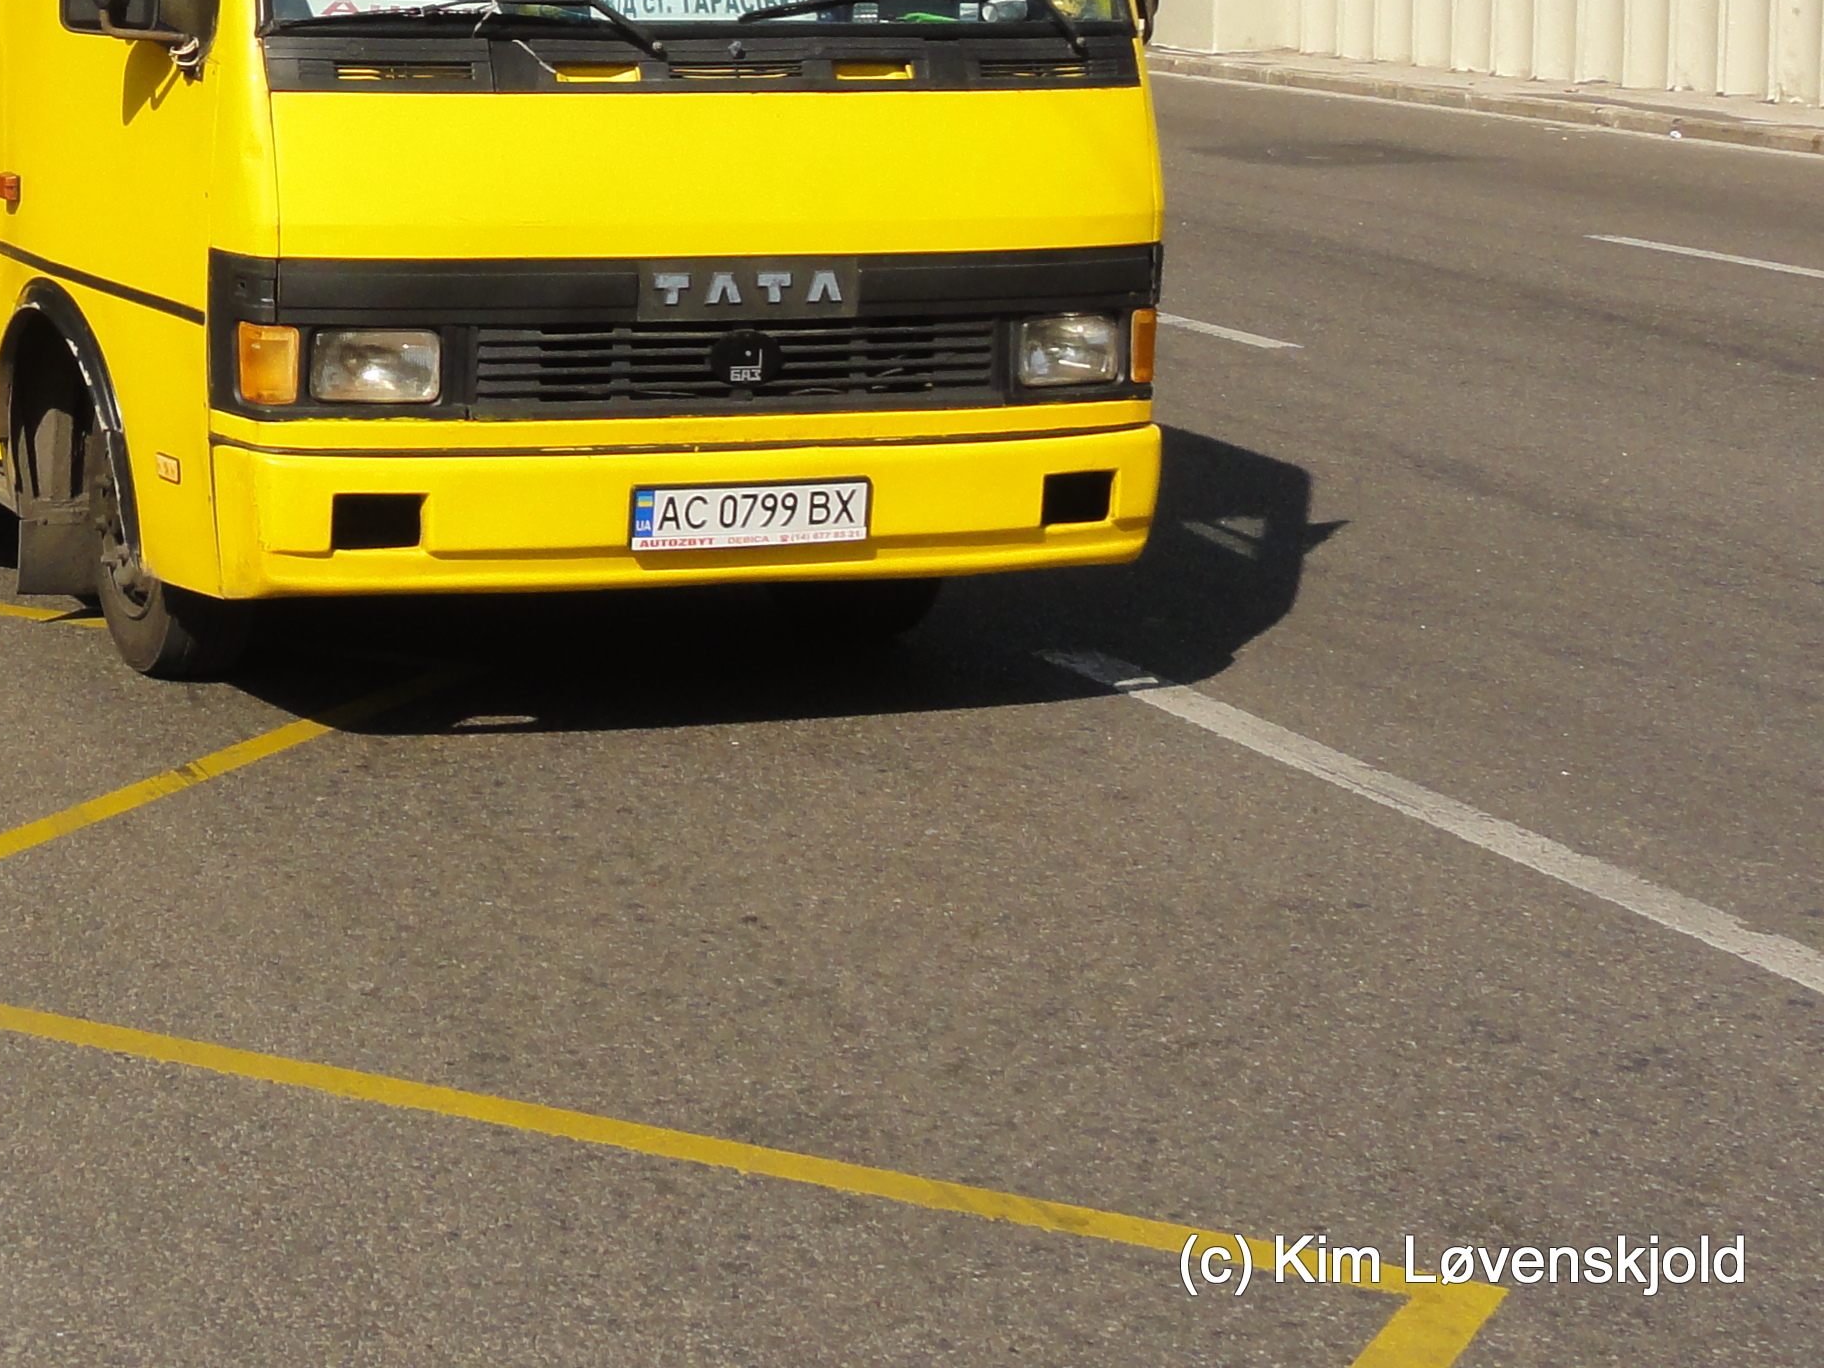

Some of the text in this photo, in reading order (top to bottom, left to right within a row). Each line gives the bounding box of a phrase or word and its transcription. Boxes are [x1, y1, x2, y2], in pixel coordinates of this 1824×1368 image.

[653, 269, 843, 305] TATA
[636, 488, 857, 532] UA AC 0799 BX
[639, 536, 716, 548] AUTOZBYT
